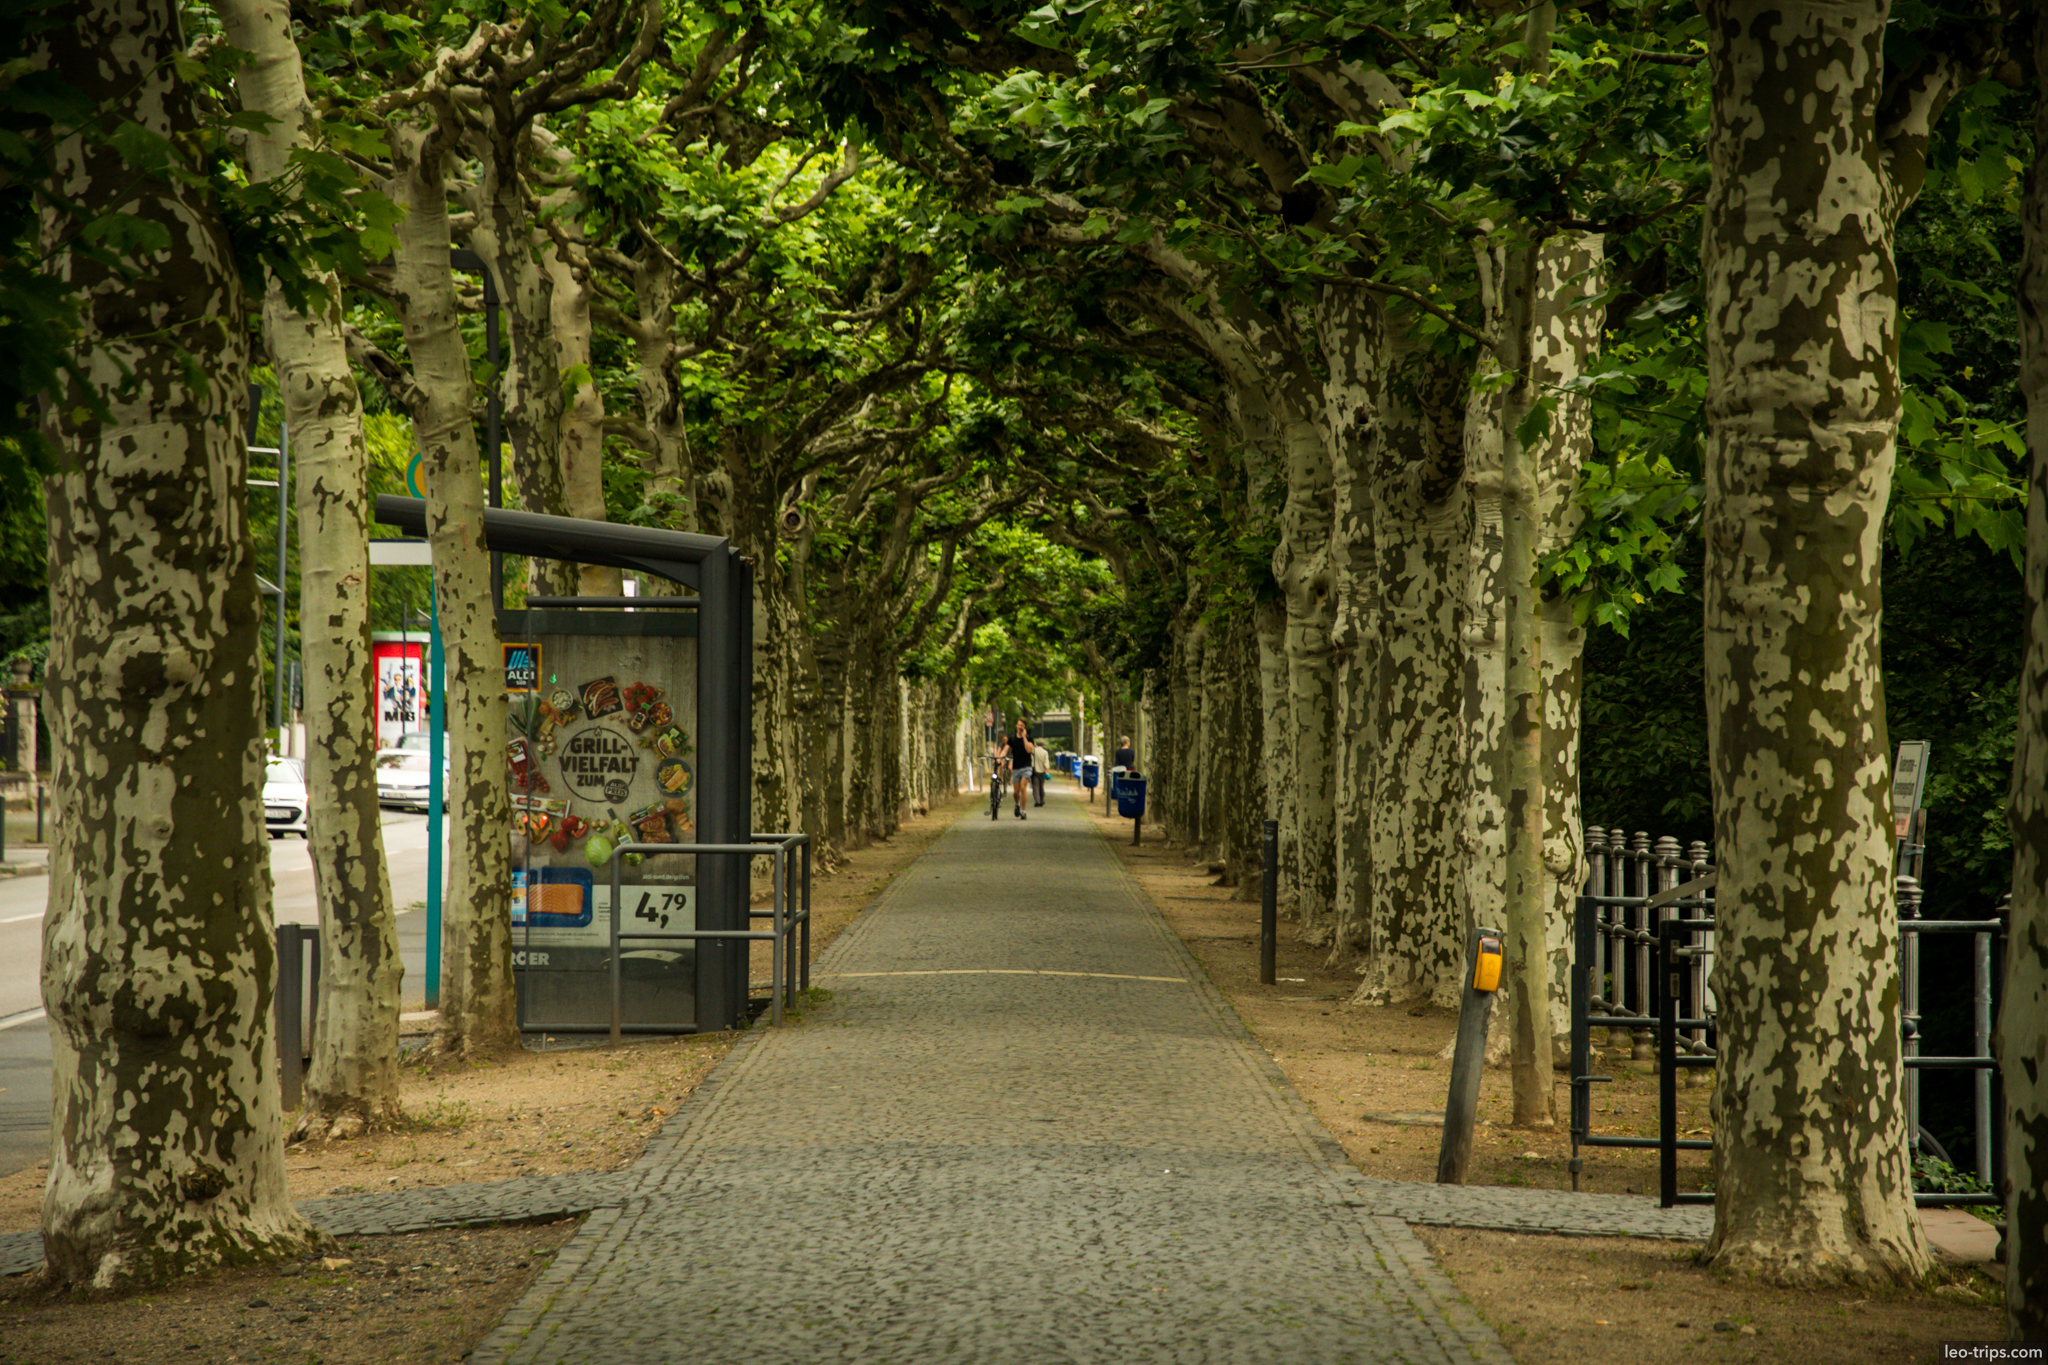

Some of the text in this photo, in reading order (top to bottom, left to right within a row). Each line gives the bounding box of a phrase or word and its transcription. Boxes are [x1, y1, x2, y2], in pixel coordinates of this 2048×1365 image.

[508, 671, 534, 679] ALDI
[570, 738, 628, 754] GRILL-
[559, 757, 640, 773] VIELFALT
[577, 774, 605, 787] ZUM
[606, 788, 626, 796] PREIS
[635, 891, 687, 929] 4,79
